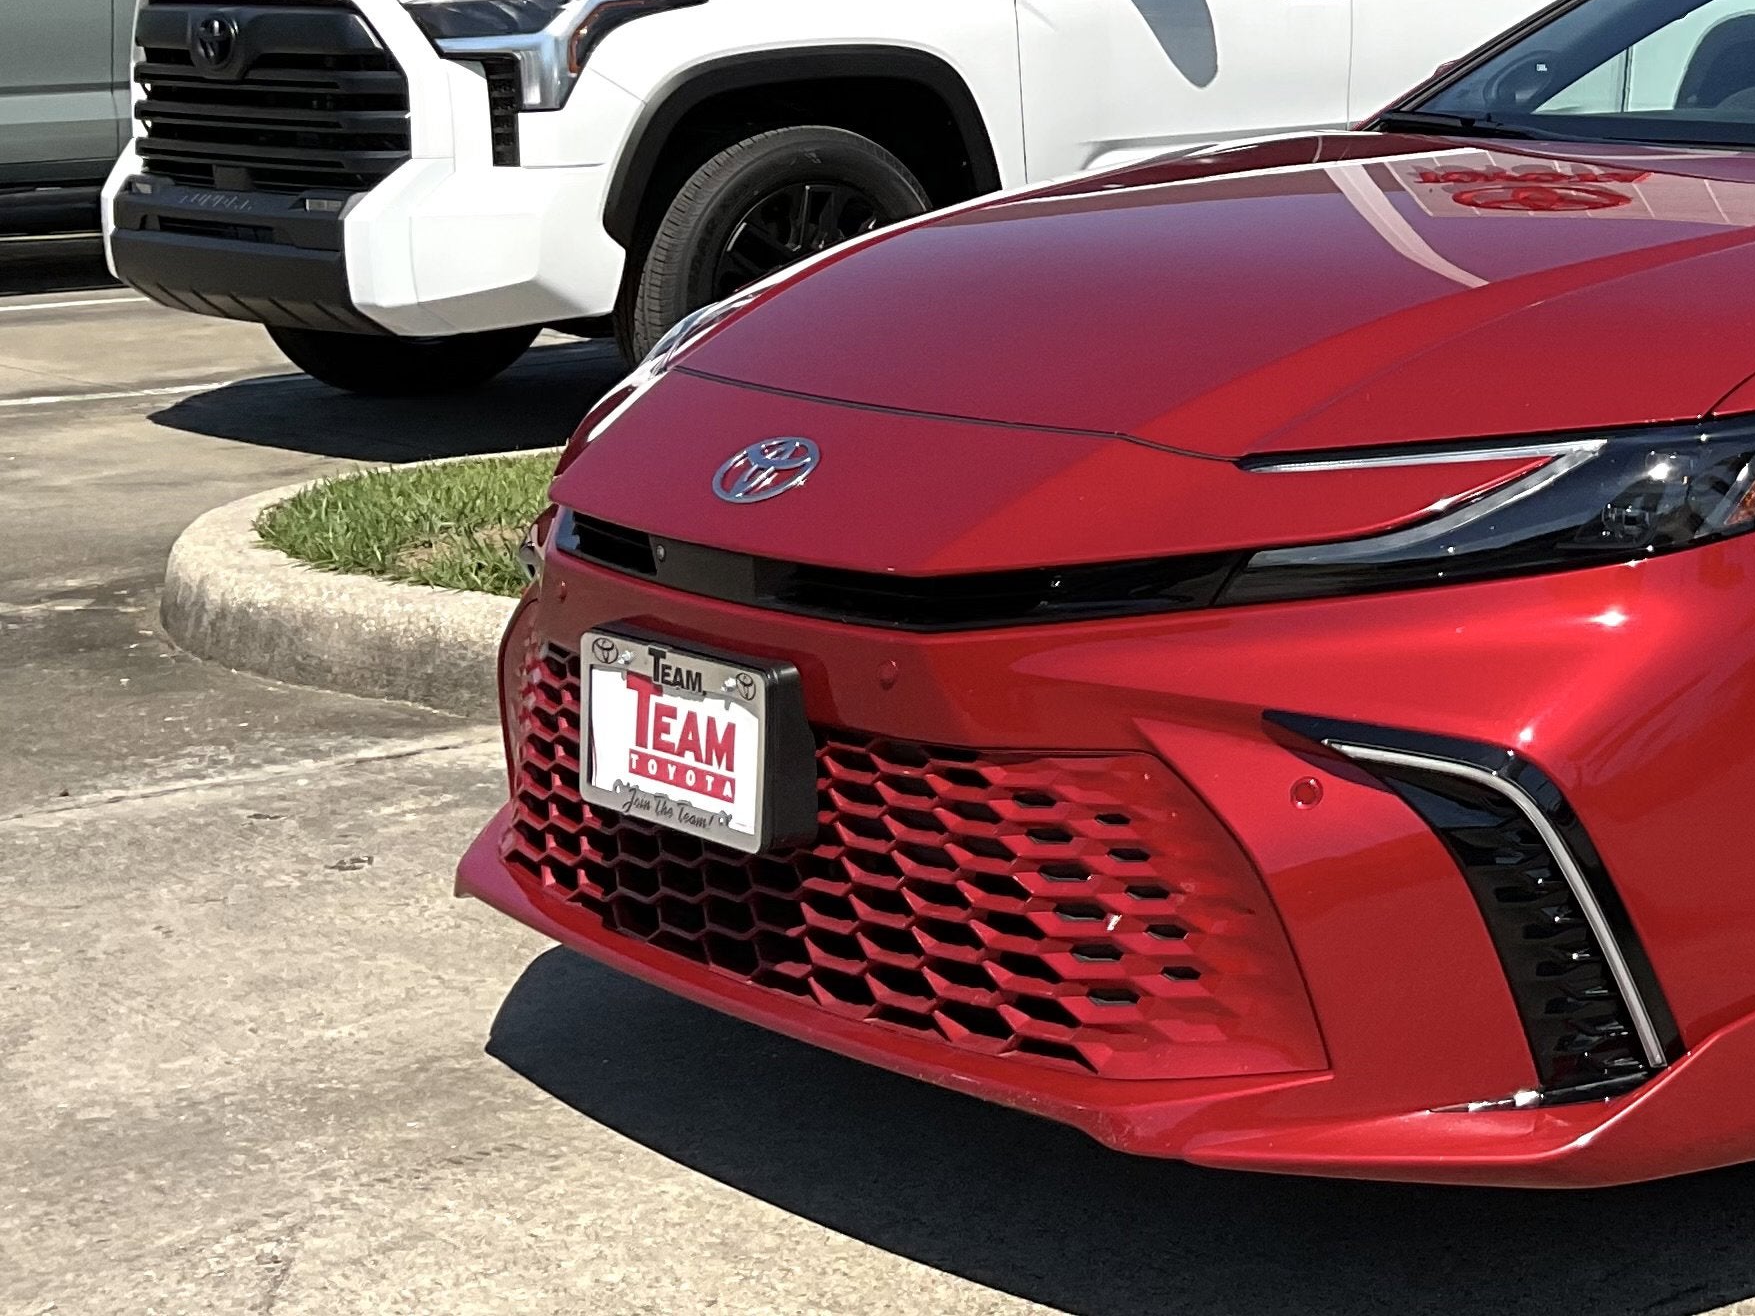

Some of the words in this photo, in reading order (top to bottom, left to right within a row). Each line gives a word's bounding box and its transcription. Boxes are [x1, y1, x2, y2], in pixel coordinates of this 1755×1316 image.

[626, 671, 736, 772] TEAM
[630, 754, 735, 798] TOYOTA
[622, 787, 651, 813] Join
[653, 799, 674, 819] The
[676, 804, 714, 829] Team!
